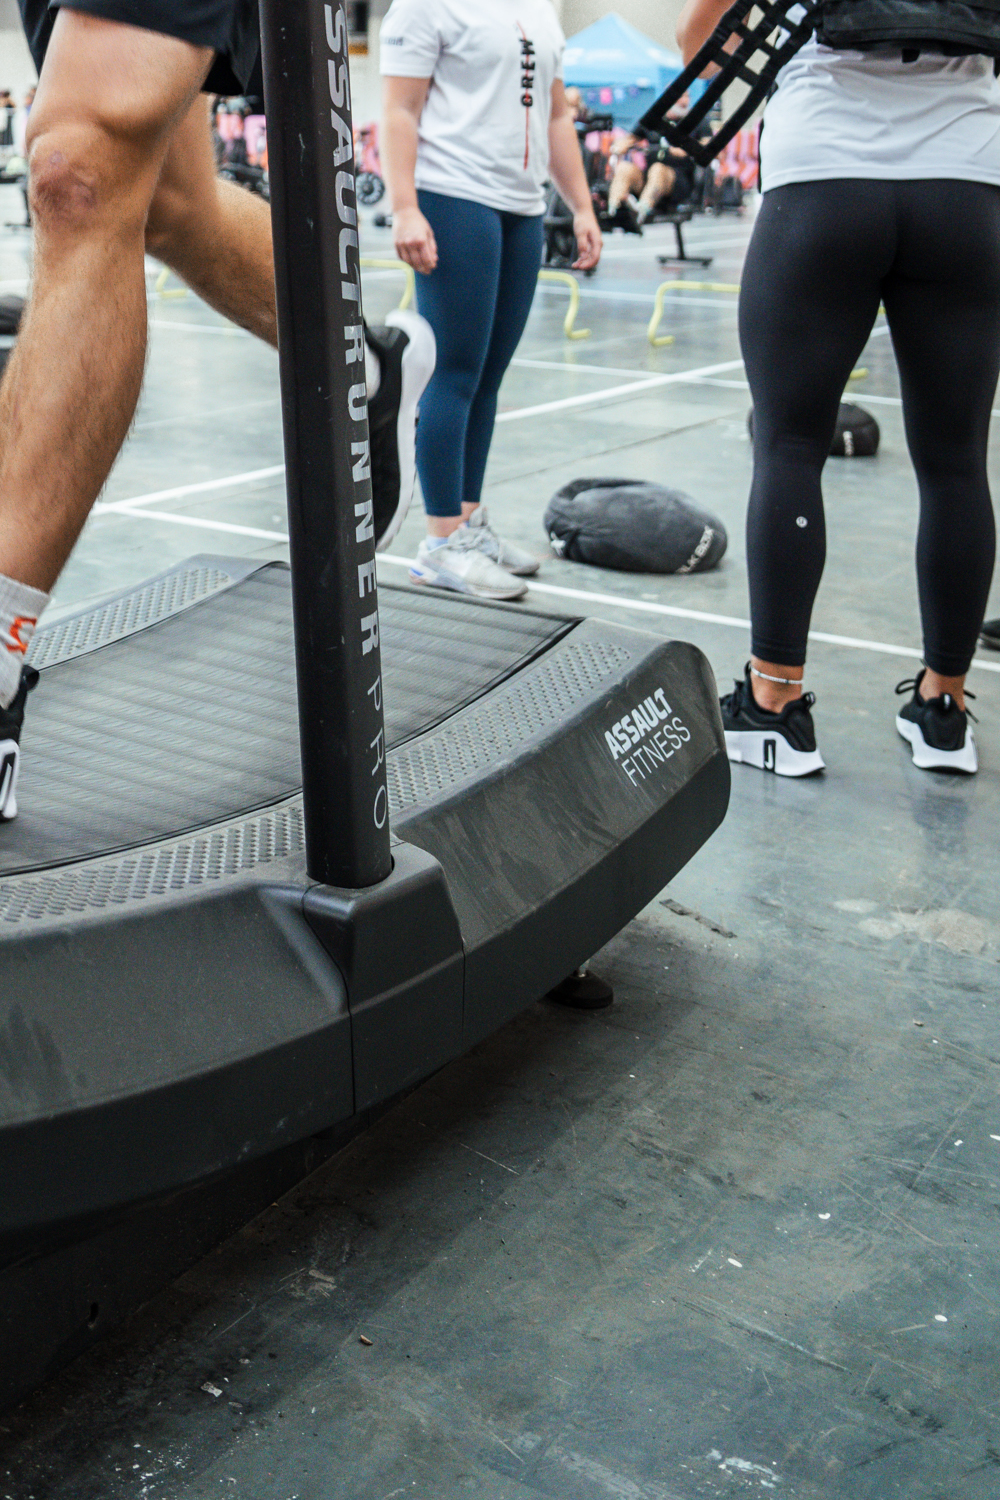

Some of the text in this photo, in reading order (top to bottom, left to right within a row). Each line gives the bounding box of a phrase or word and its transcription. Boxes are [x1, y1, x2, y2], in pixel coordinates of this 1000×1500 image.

[367, 674, 388, 830] PRO
[604, 687, 673, 760] ASSAULT
[621, 717, 691, 787] FITNESS
